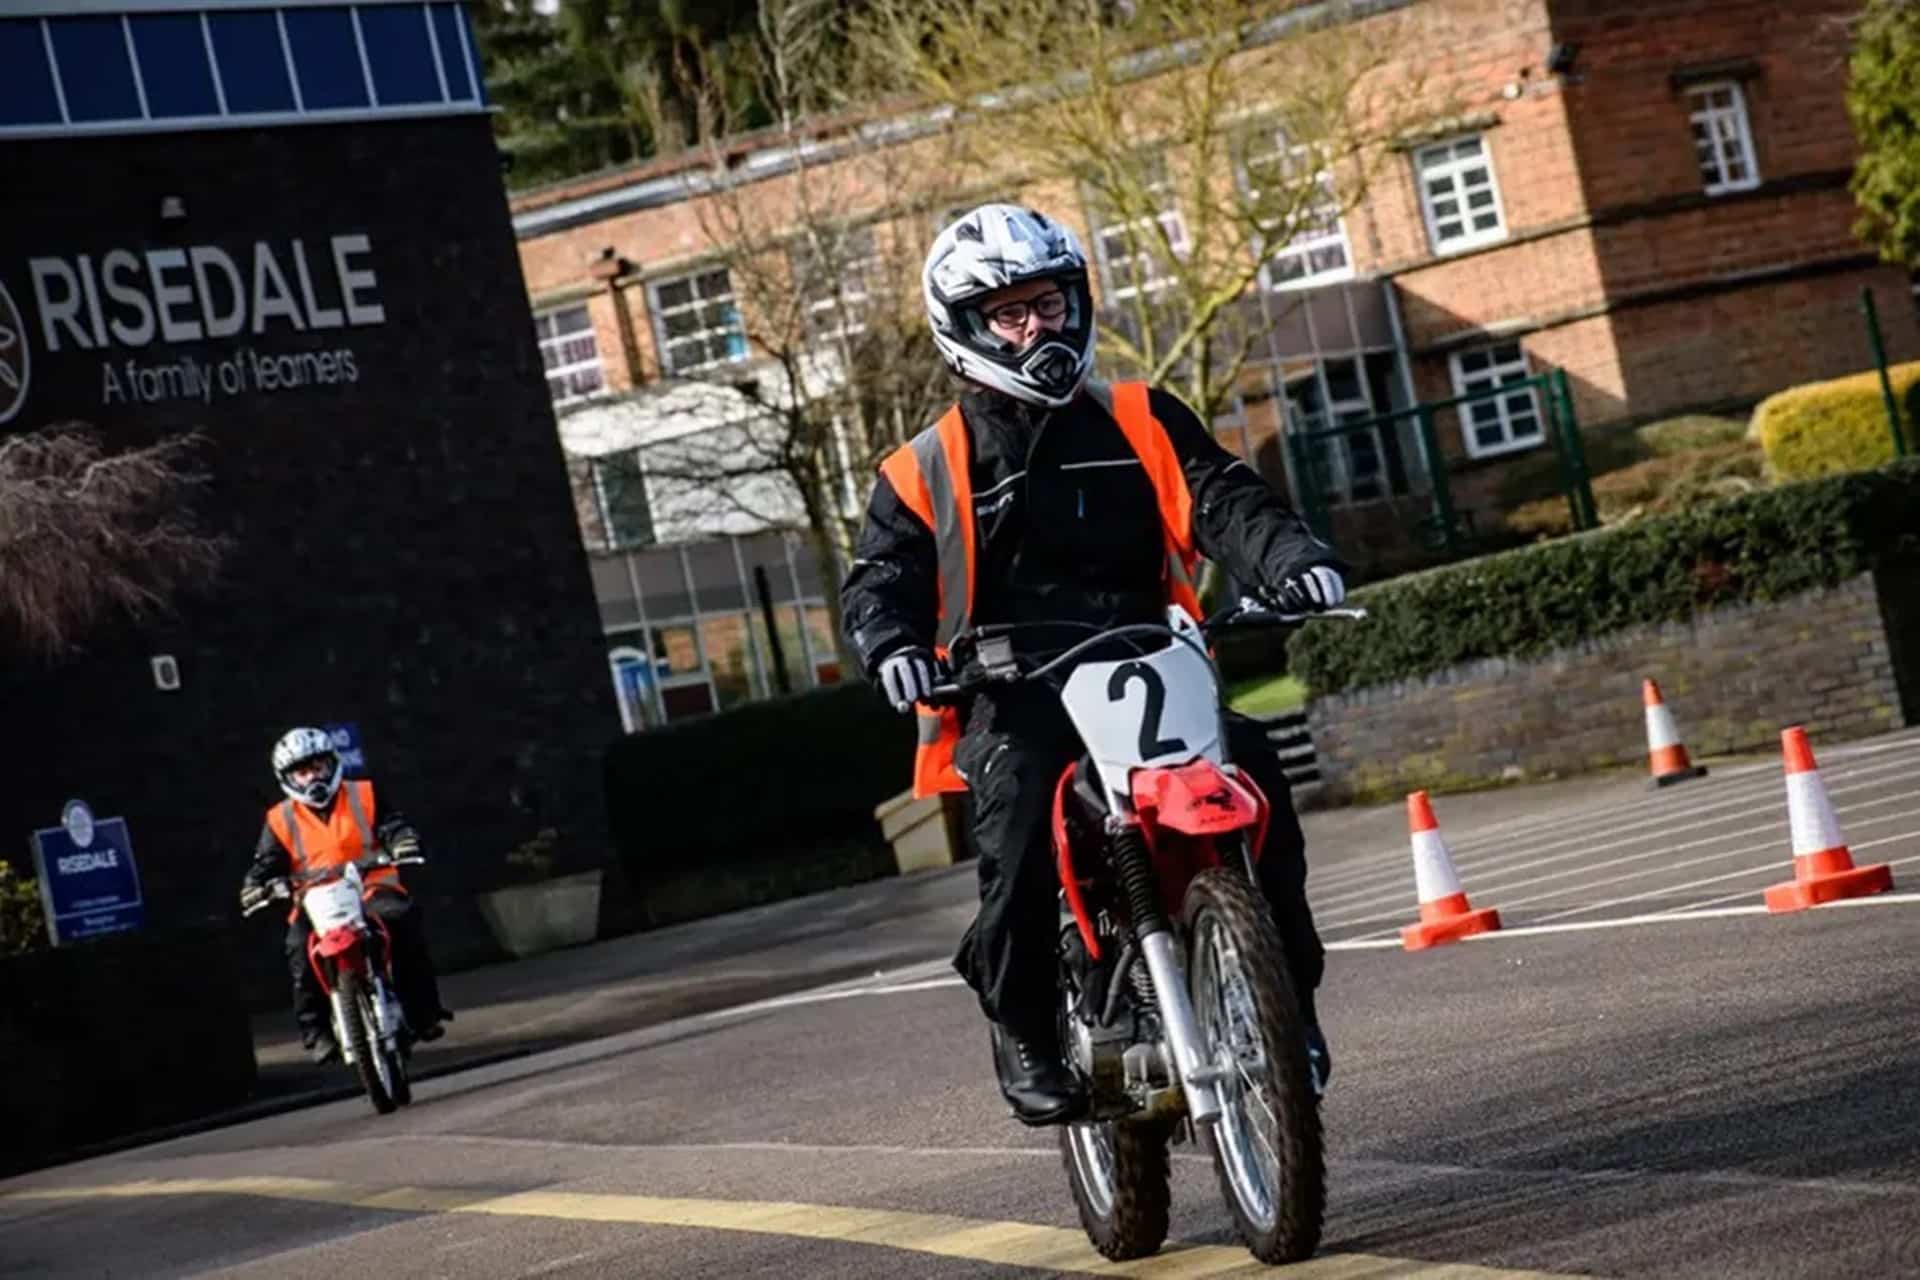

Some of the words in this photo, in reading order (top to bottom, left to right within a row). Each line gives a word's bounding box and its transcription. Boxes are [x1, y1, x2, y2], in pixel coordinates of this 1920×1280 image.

[29, 234, 385, 351] RISEDALE
[103, 363, 125, 404] A
[127, 354, 212, 405] family
[219, 350, 246, 395] of
[250, 347, 358, 391] learners
[1107, 661, 1187, 760] 2
[58, 849, 117, 874] RISEDALE
